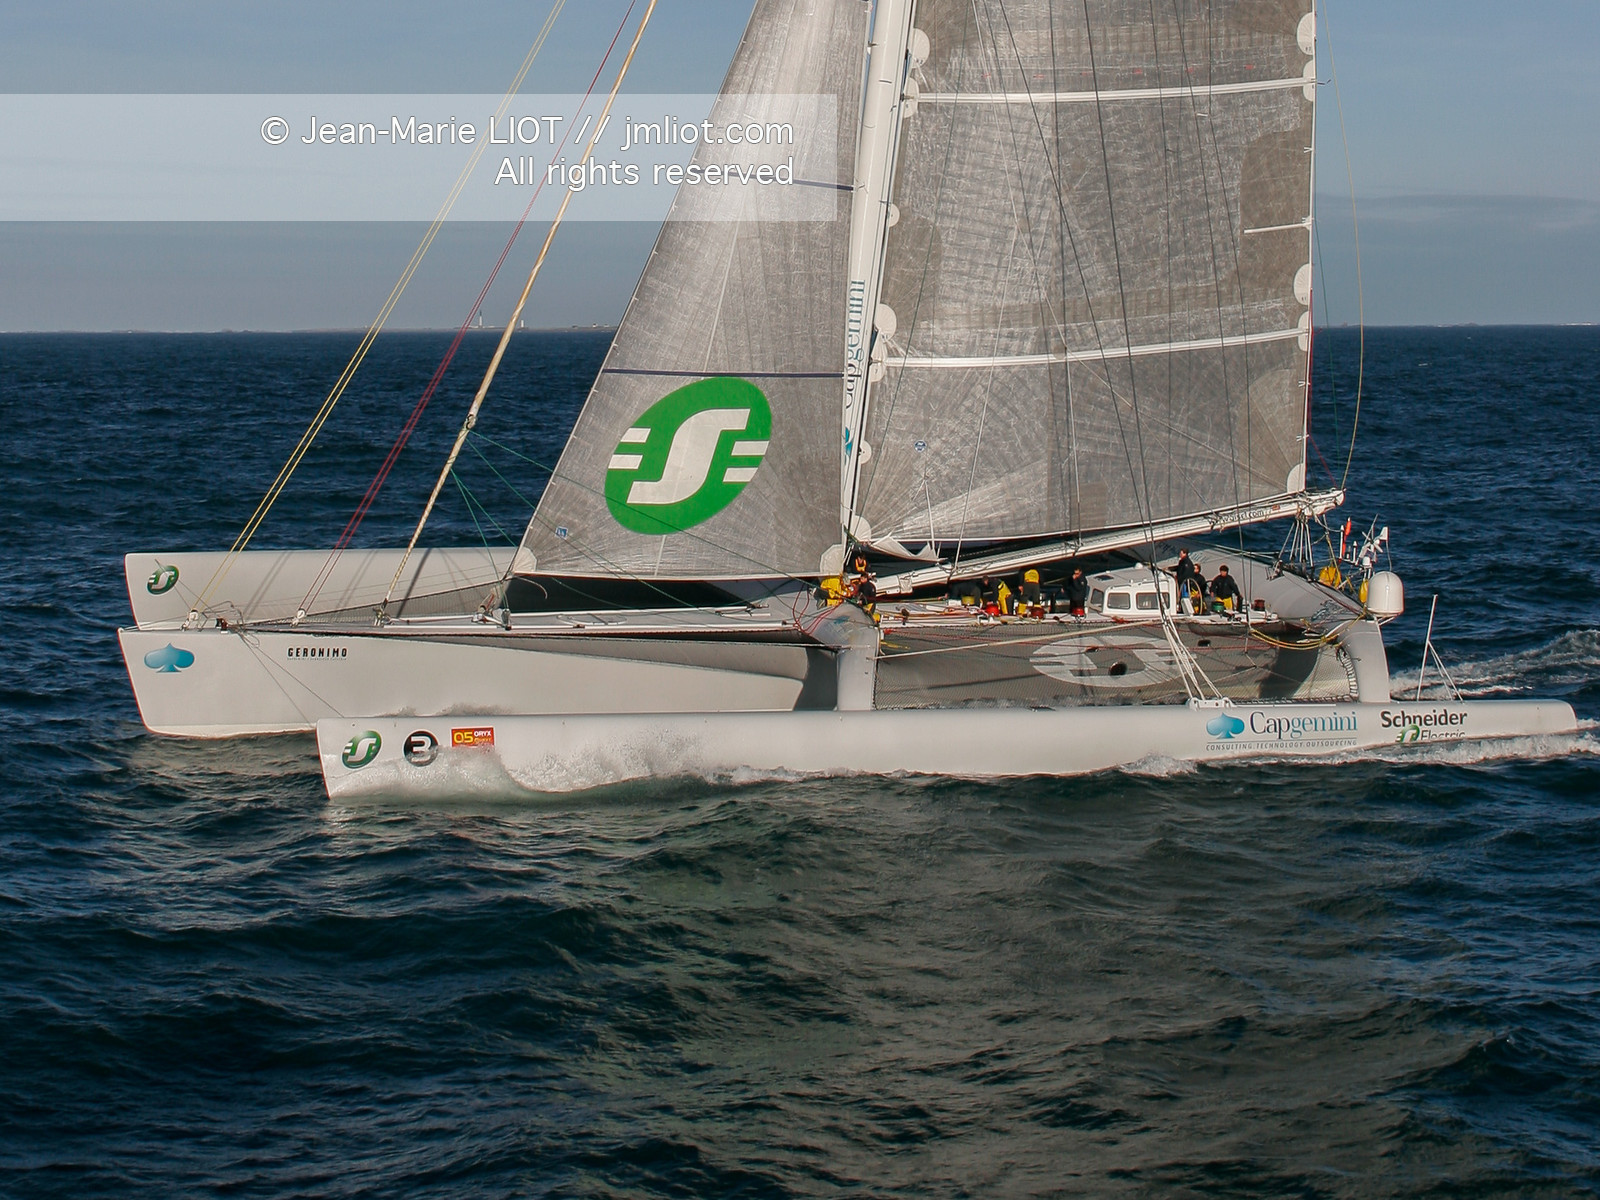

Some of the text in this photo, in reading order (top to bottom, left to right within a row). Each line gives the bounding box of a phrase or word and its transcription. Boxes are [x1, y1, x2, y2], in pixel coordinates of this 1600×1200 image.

[287, 647, 348, 658] GERONIMO
[1250, 710, 1358, 740] Capgemini
[1380, 708, 1468, 728] Schneider
